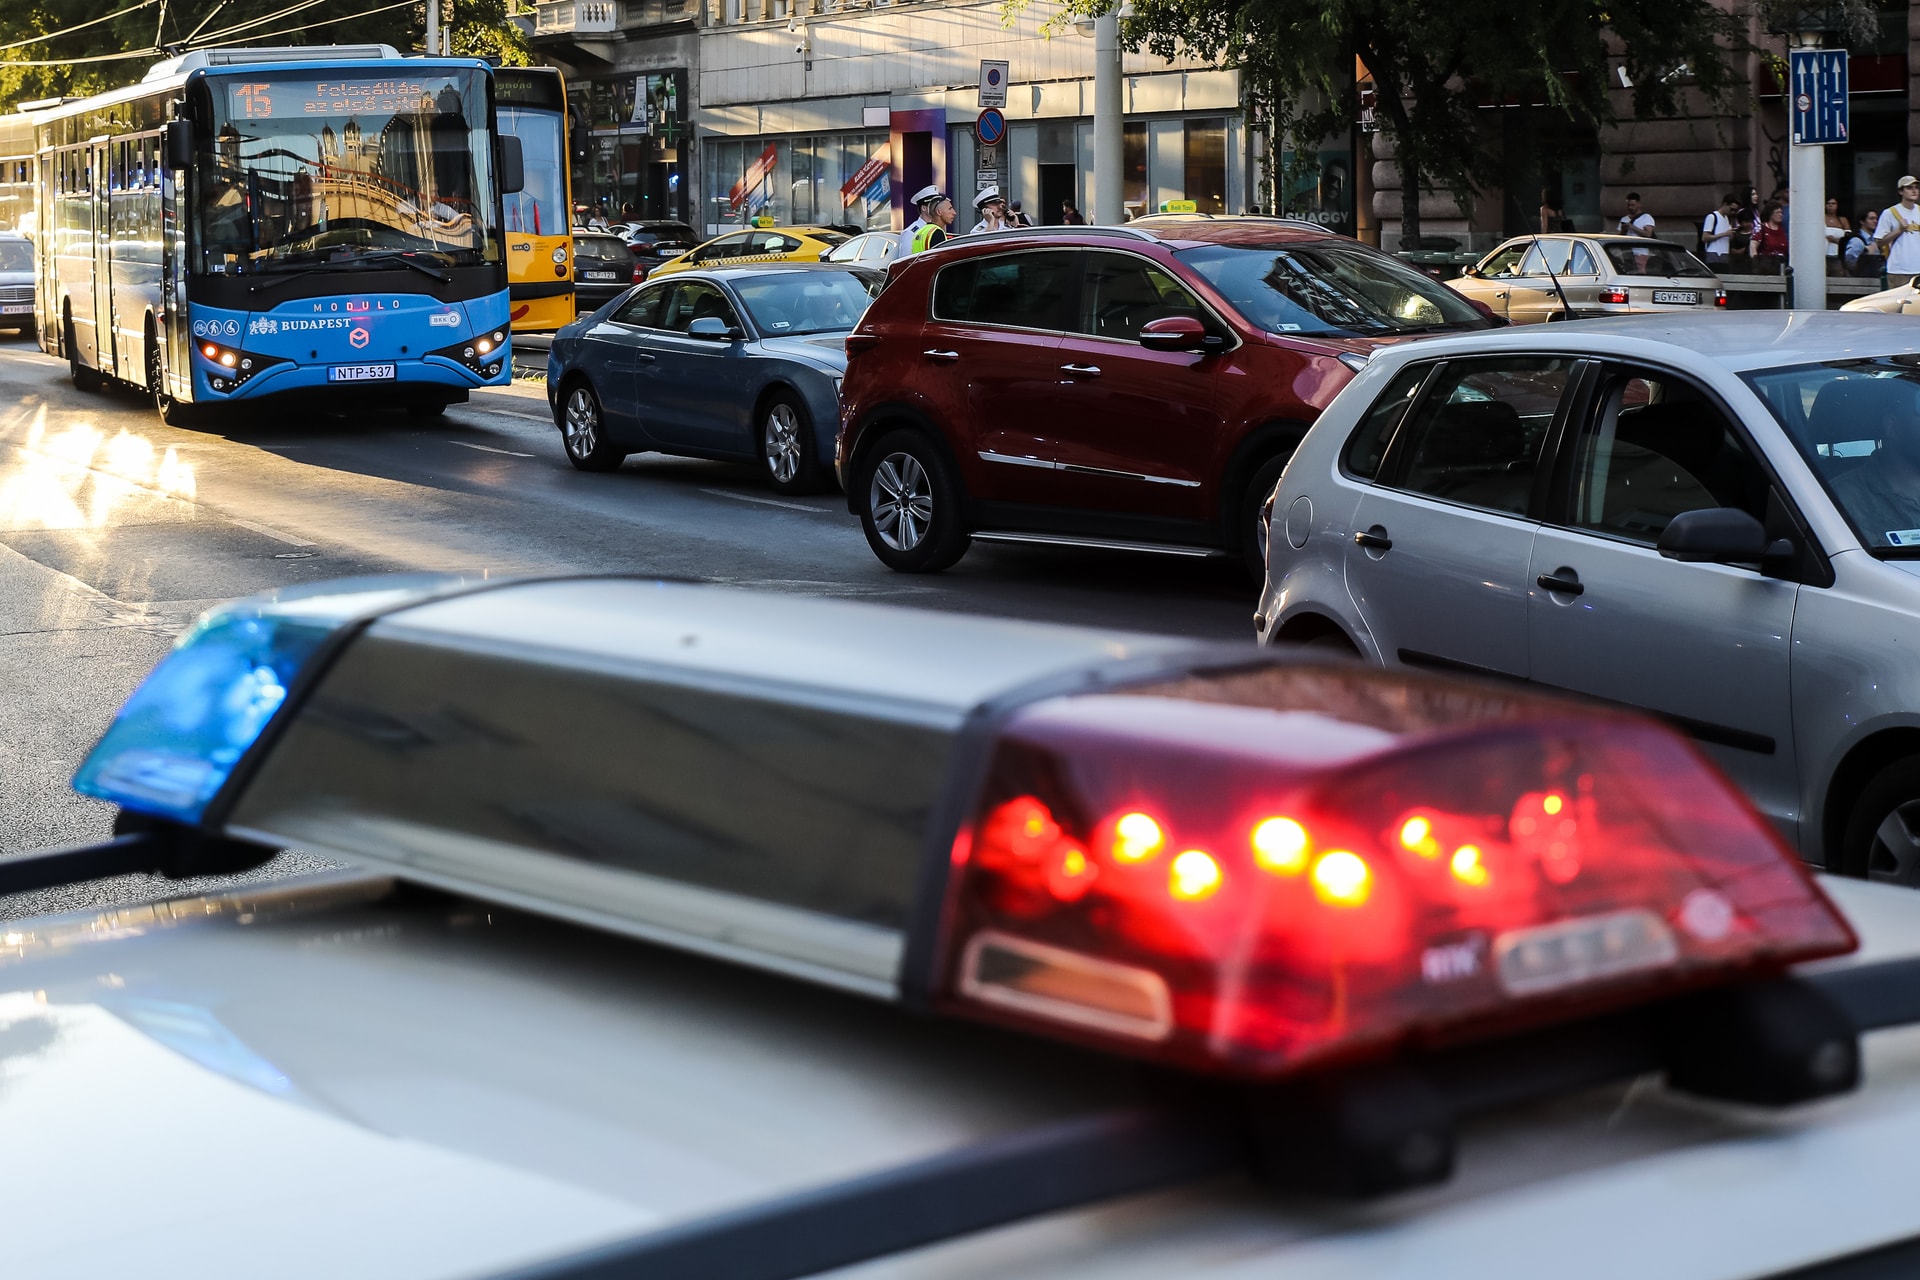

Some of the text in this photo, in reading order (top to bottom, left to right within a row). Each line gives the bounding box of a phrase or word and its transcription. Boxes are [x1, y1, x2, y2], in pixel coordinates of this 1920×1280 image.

[495, 82, 532, 90] igmond
[236, 83, 272, 118] 15
[304, 102, 328, 112] az
[1285, 211, 1349, 224] SHAGGY
[313, 300, 400, 312] MODULO
[281, 318, 352, 331] BUDAPEST
[337, 366, 392, 379] NTP-537
